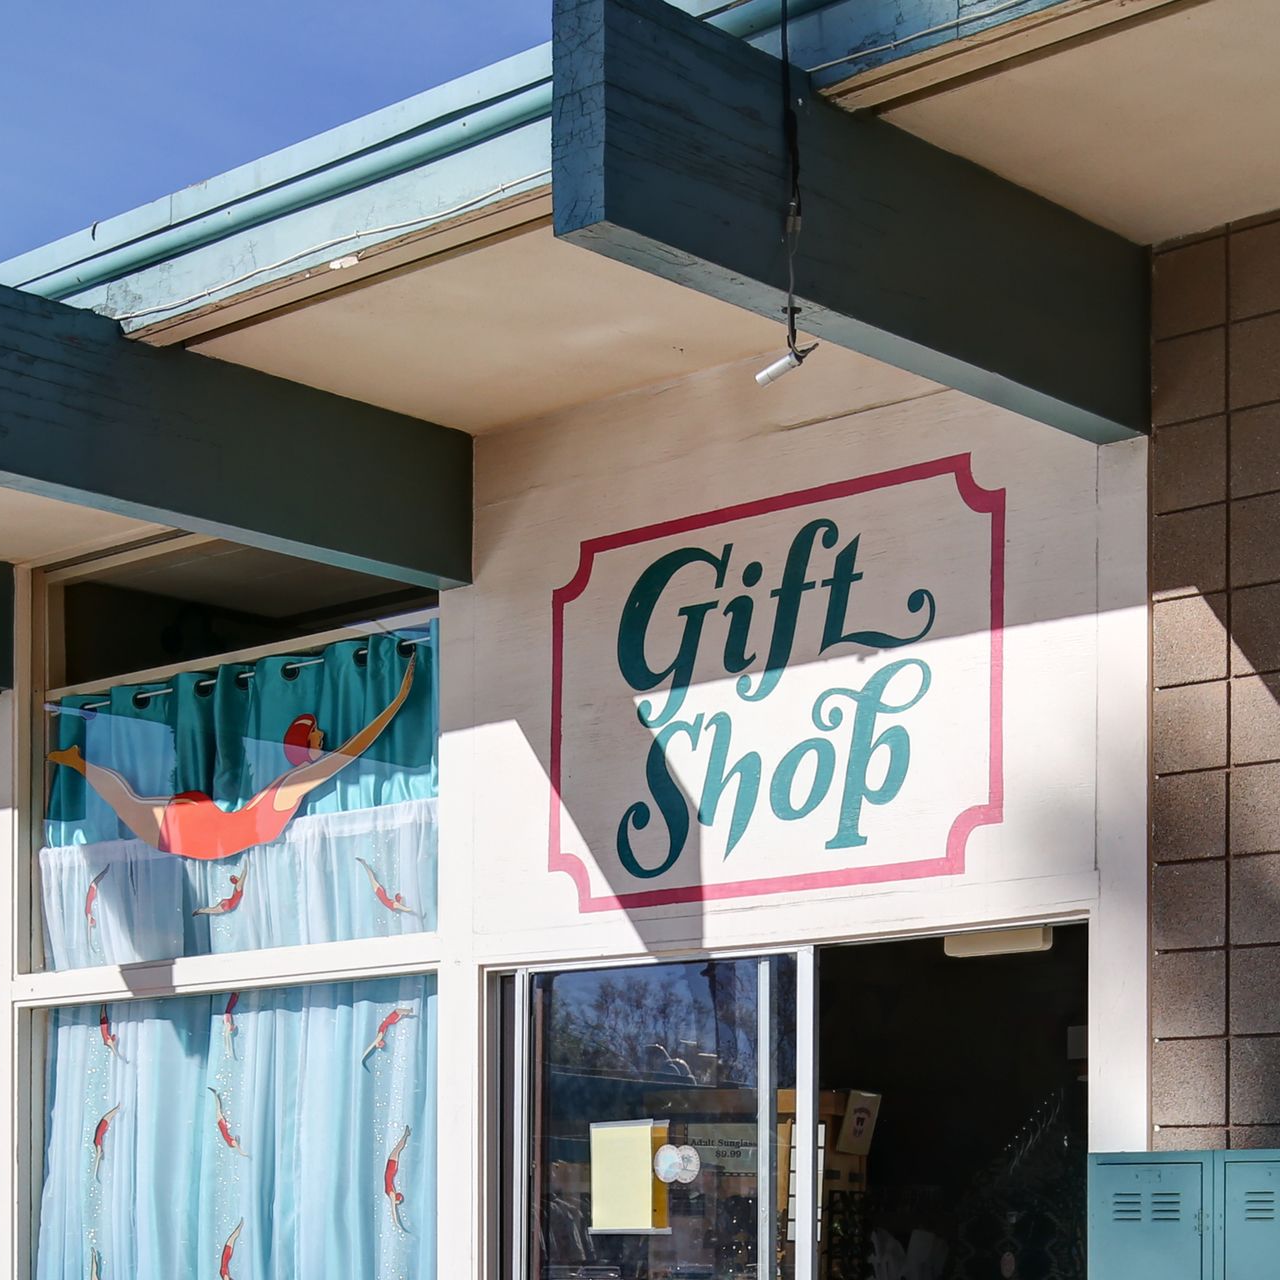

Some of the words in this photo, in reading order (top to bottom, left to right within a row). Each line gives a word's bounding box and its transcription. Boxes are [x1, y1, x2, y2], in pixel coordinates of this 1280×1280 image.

[618, 519, 936, 728] Gift
[617, 658, 932, 879] Shop
[690, 1138, 714, 1147] Adult
[715, 1150, 742, 1159] $9.99
